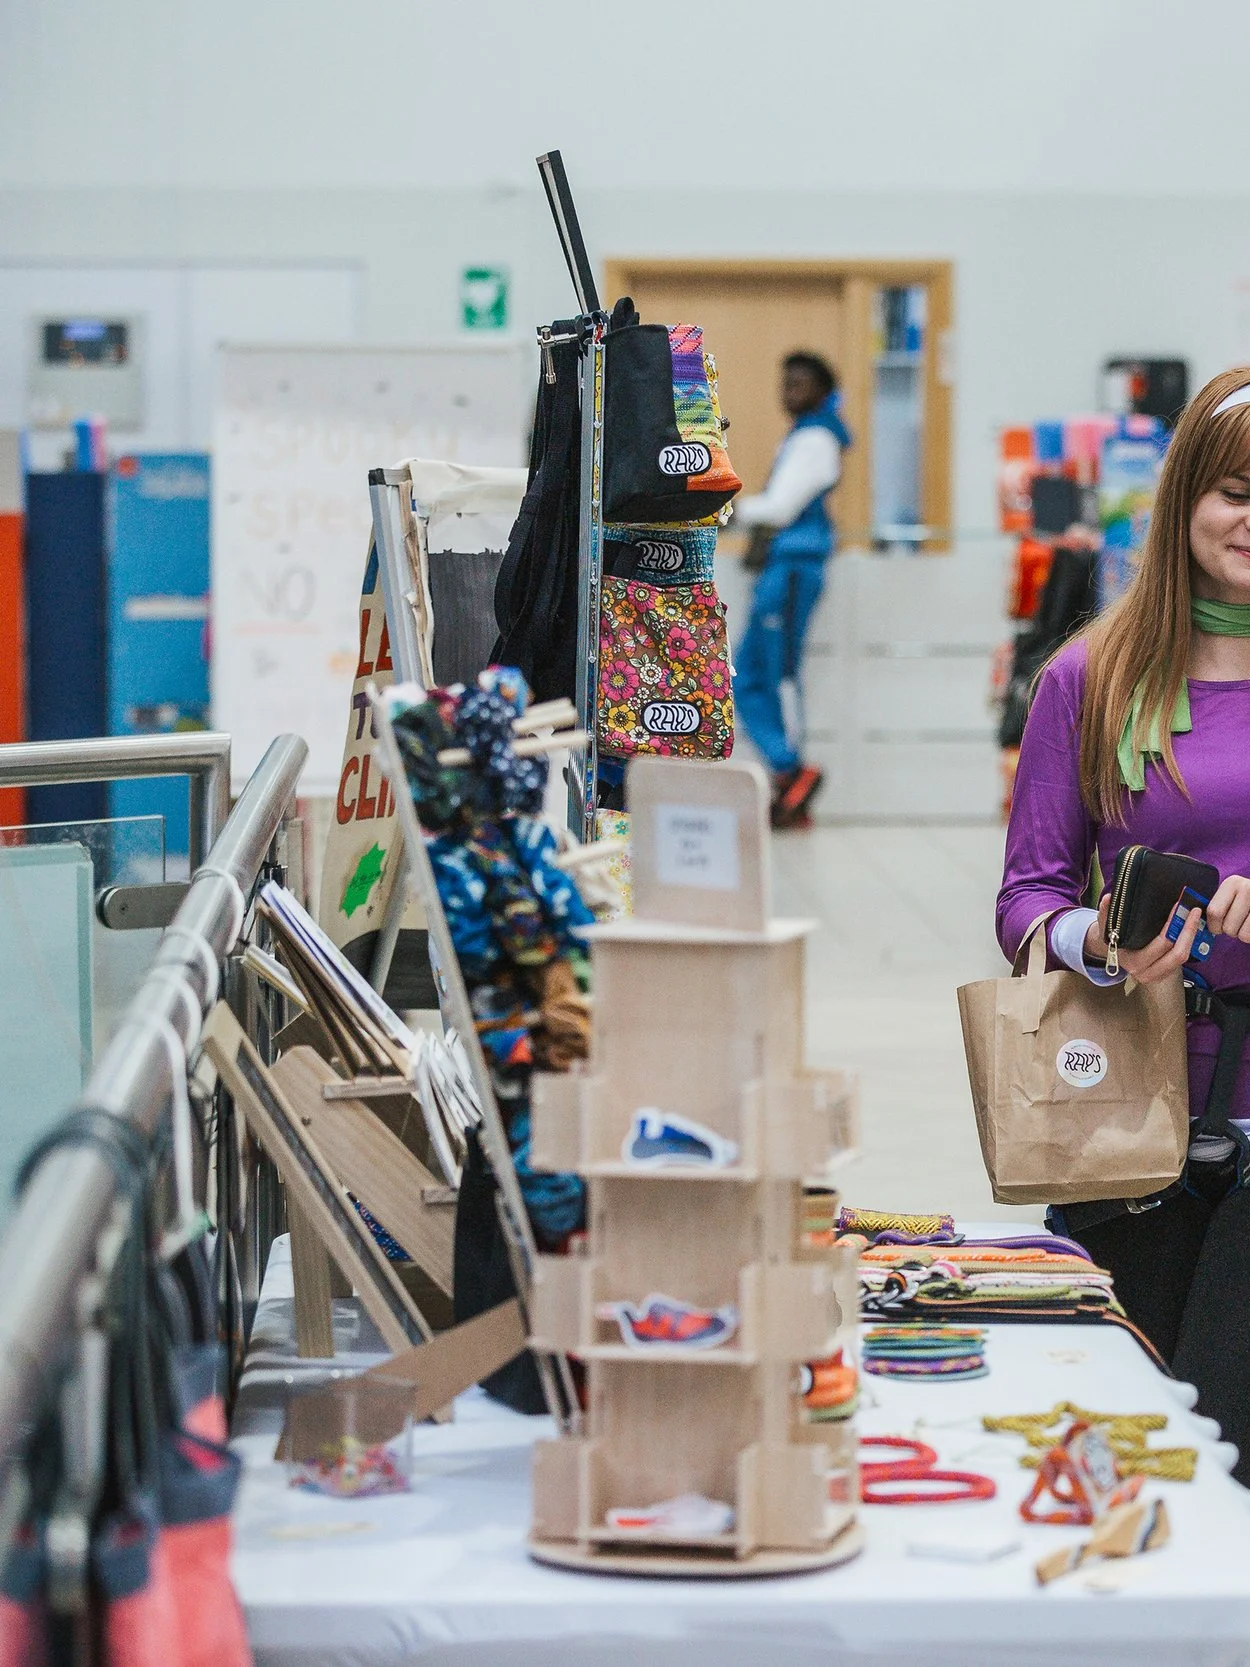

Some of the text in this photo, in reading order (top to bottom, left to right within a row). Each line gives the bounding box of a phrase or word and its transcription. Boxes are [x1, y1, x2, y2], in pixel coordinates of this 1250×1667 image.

[664, 446, 704, 472] RAY'S
[353, 692, 378, 741] T
[649, 705, 694, 731] RAY'S
[336, 754, 397, 825] CLI
[1064, 1051, 1102, 1073] RAY'S
